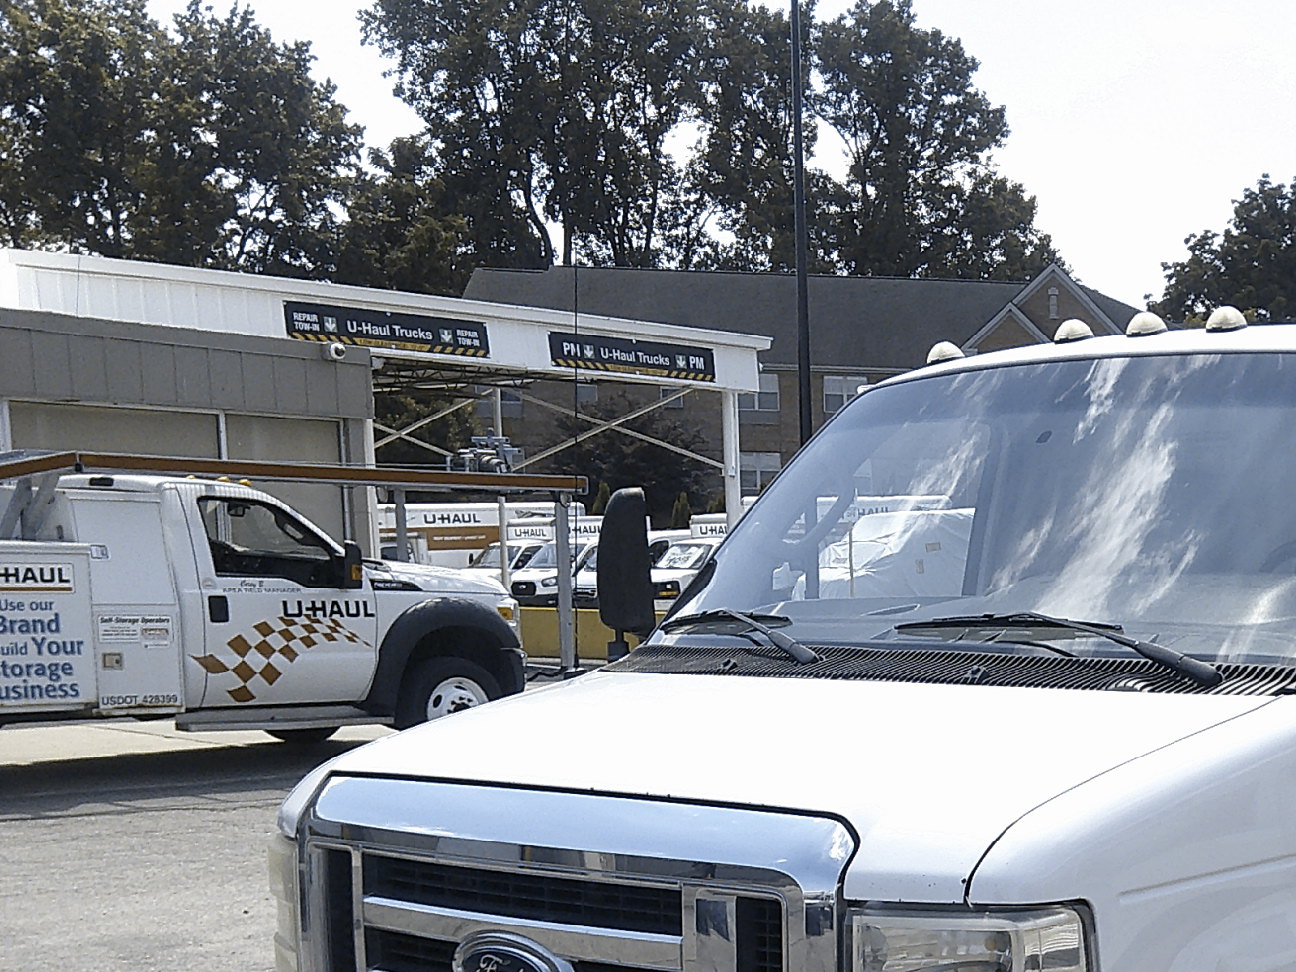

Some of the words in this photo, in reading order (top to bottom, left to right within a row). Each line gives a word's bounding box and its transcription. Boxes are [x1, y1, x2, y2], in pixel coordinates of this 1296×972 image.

[293, 311, 319, 322] REPAIR
[294, 322, 320, 332] TOW-IN
[346, 320, 390, 336] U-Haul
[391, 326, 433, 340] Trucks
[456, 329, 479, 339] REPAIR
[457, 337, 480, 347] TOW-IN
[563, 342, 581, 357] PM
[600, 348, 636, 363] U-Haul
[637, 352, 670, 366] Trucks
[689, 355, 705, 370] PM
[424, 513, 481, 524] U-HAUL
[514, 528, 547, 538] U-HAUL
[0, 567, 71, 584] -HAUL
[0, 599, 25, 611] Use
[30, 600, 55, 611] our
[282, 600, 376, 618] U-HAUL
[1, 641, 28, 656] uild
[31, 636, 84, 656] Your
[1, 660, 74, 683] torage
[0, 679, 80, 700] usiness
[101, 695, 138, 705] USDOT
